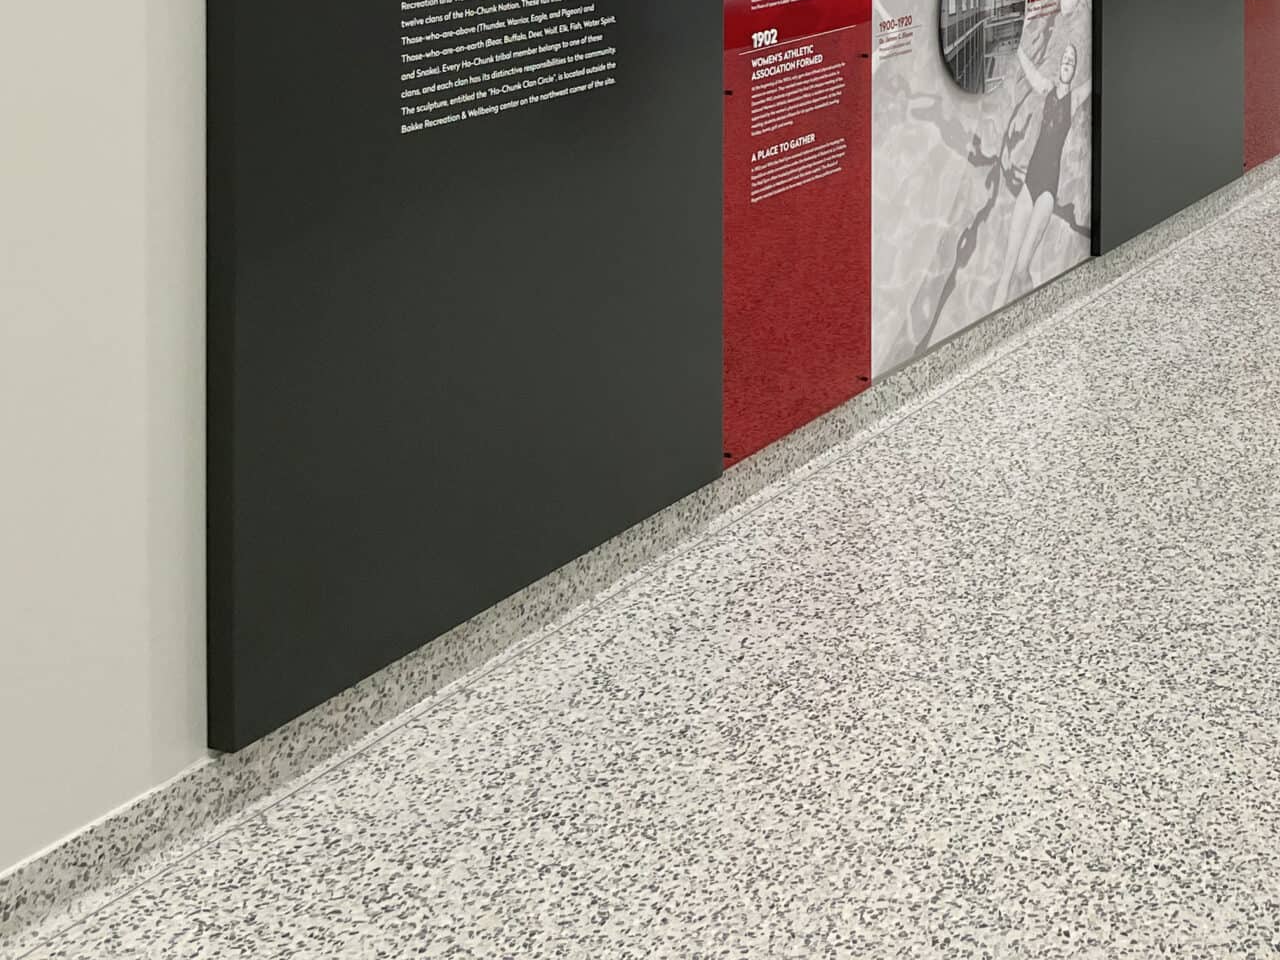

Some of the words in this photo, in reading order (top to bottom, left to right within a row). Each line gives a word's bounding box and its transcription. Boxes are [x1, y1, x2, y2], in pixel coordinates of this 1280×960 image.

[879, 15, 913, 32] 1900-1920
[751, 29, 778, 48] 1902
[783, 45, 814, 61] ATHLETIC
[751, 63, 796, 81] ASSOCIATION
[796, 54, 823, 70] FORMED
[751, 152, 756, 162] A
[757, 146, 779, 161] PLACE
[779, 143, 788, 153] TO
[789, 133, 816, 150] GATHER
